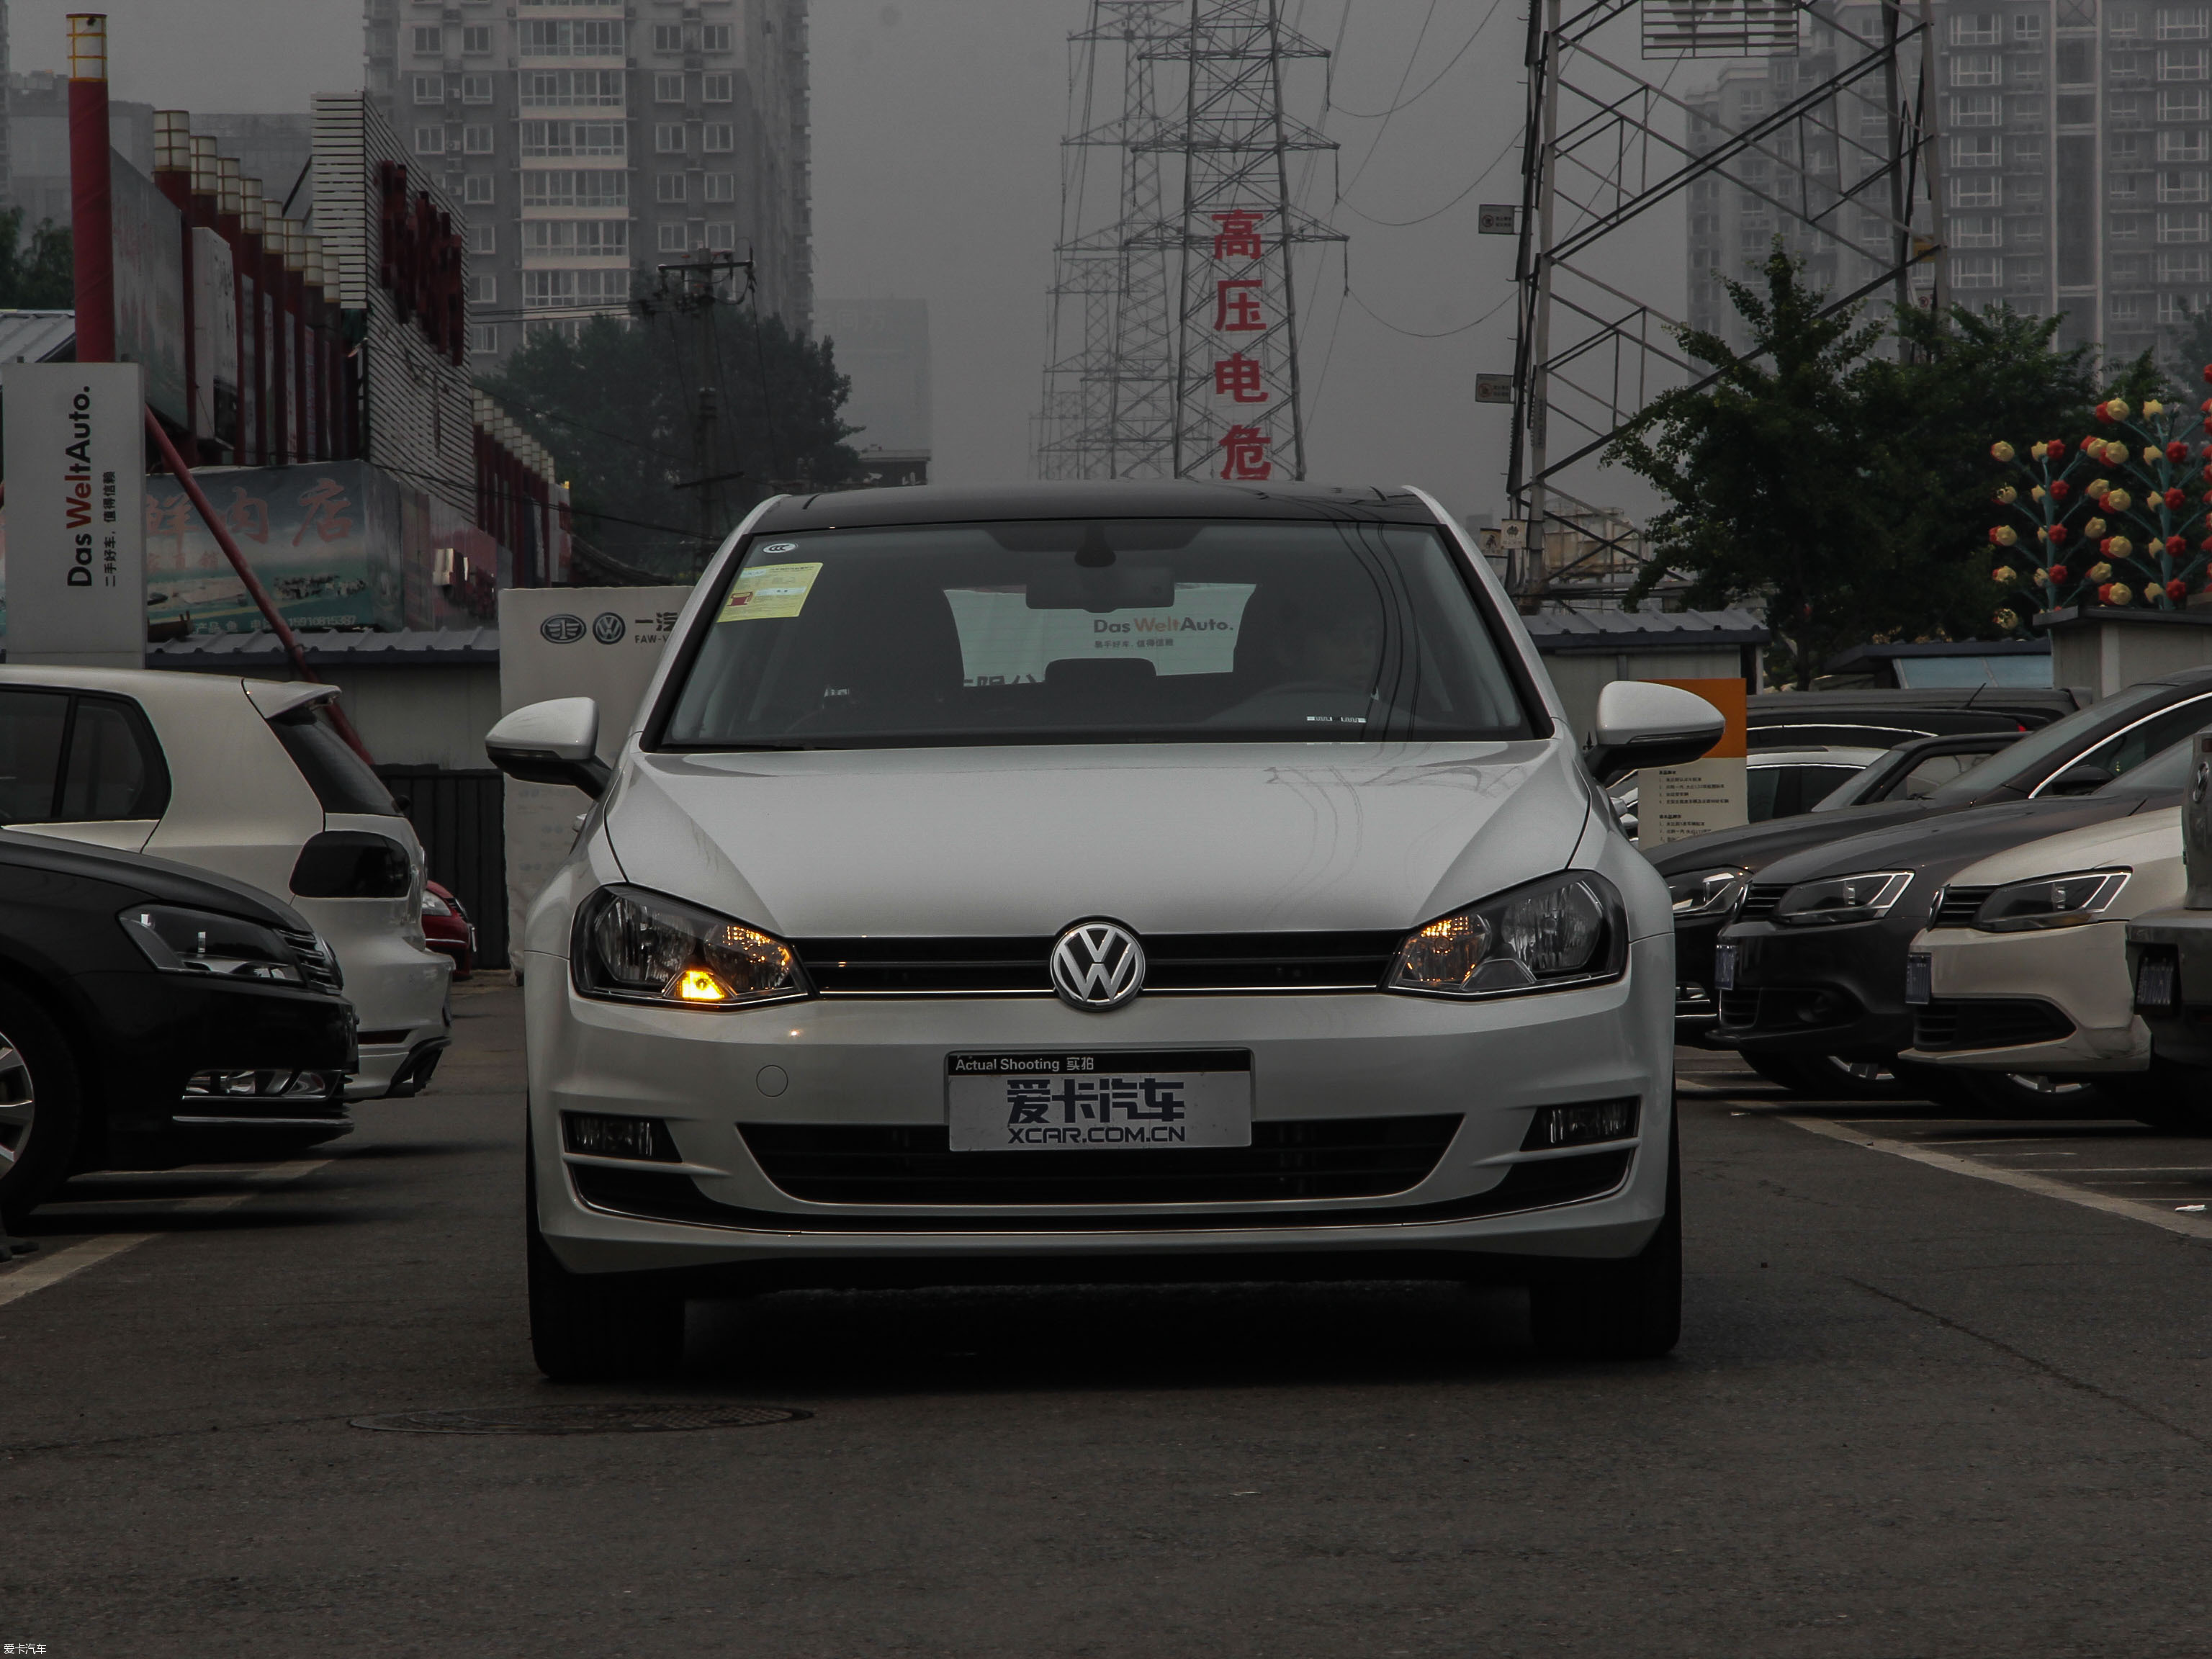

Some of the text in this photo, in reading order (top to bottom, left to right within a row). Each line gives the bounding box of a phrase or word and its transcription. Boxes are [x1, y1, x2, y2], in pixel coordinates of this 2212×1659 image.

[1212, 209, 1272, 480] 高压电危
[64, 386, 92, 586] Das WeltAuto.
[1094, 616, 1233, 634] Das WeltAuto.
[956, 1056, 1094, 1072] Actual Shooting 实拍
[1007, 1078, 1184, 1124] 爱卡汽车
[1008, 1126, 1185, 1143] XCAR.COM.CN
